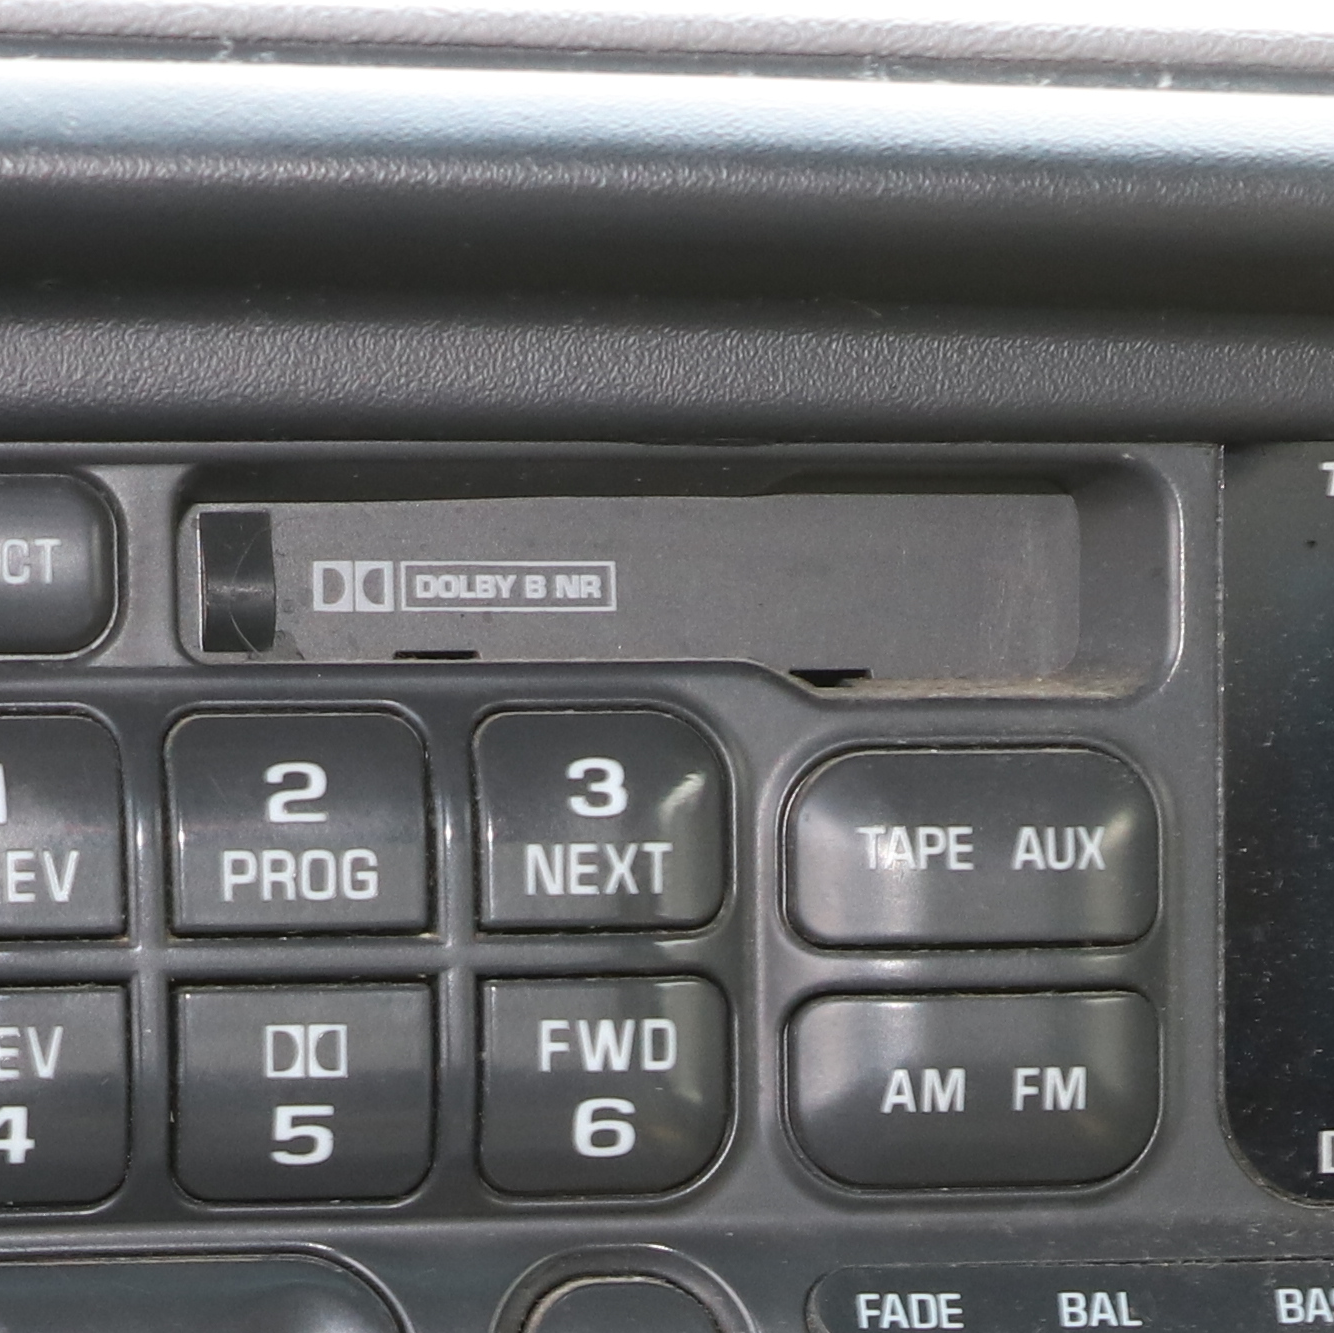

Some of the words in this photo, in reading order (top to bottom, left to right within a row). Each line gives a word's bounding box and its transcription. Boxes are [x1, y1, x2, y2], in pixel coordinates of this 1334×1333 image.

[415, 574, 517, 599] DOLBY
[525, 574, 547, 599] B
[555, 574, 601, 599] NR
[265, 762, 328, 824] 2
[566, 757, 629, 818] 3
[524, 842, 673, 896] NEXT
[856, 825, 974, 871] TAPE
[1012, 825, 1106, 870] AUX
[222, 849, 380, 901] PROG
[539, 1018, 678, 1073] FWD
[880, 1067, 965, 1113] AM
[1012, 1066, 1087, 1111] FM
[270, 1105, 335, 1165] 5
[573, 1098, 636, 1159] 6
[855, 1293, 964, 1330] FADE
[1056, 1291, 1143, 1328] BAL
